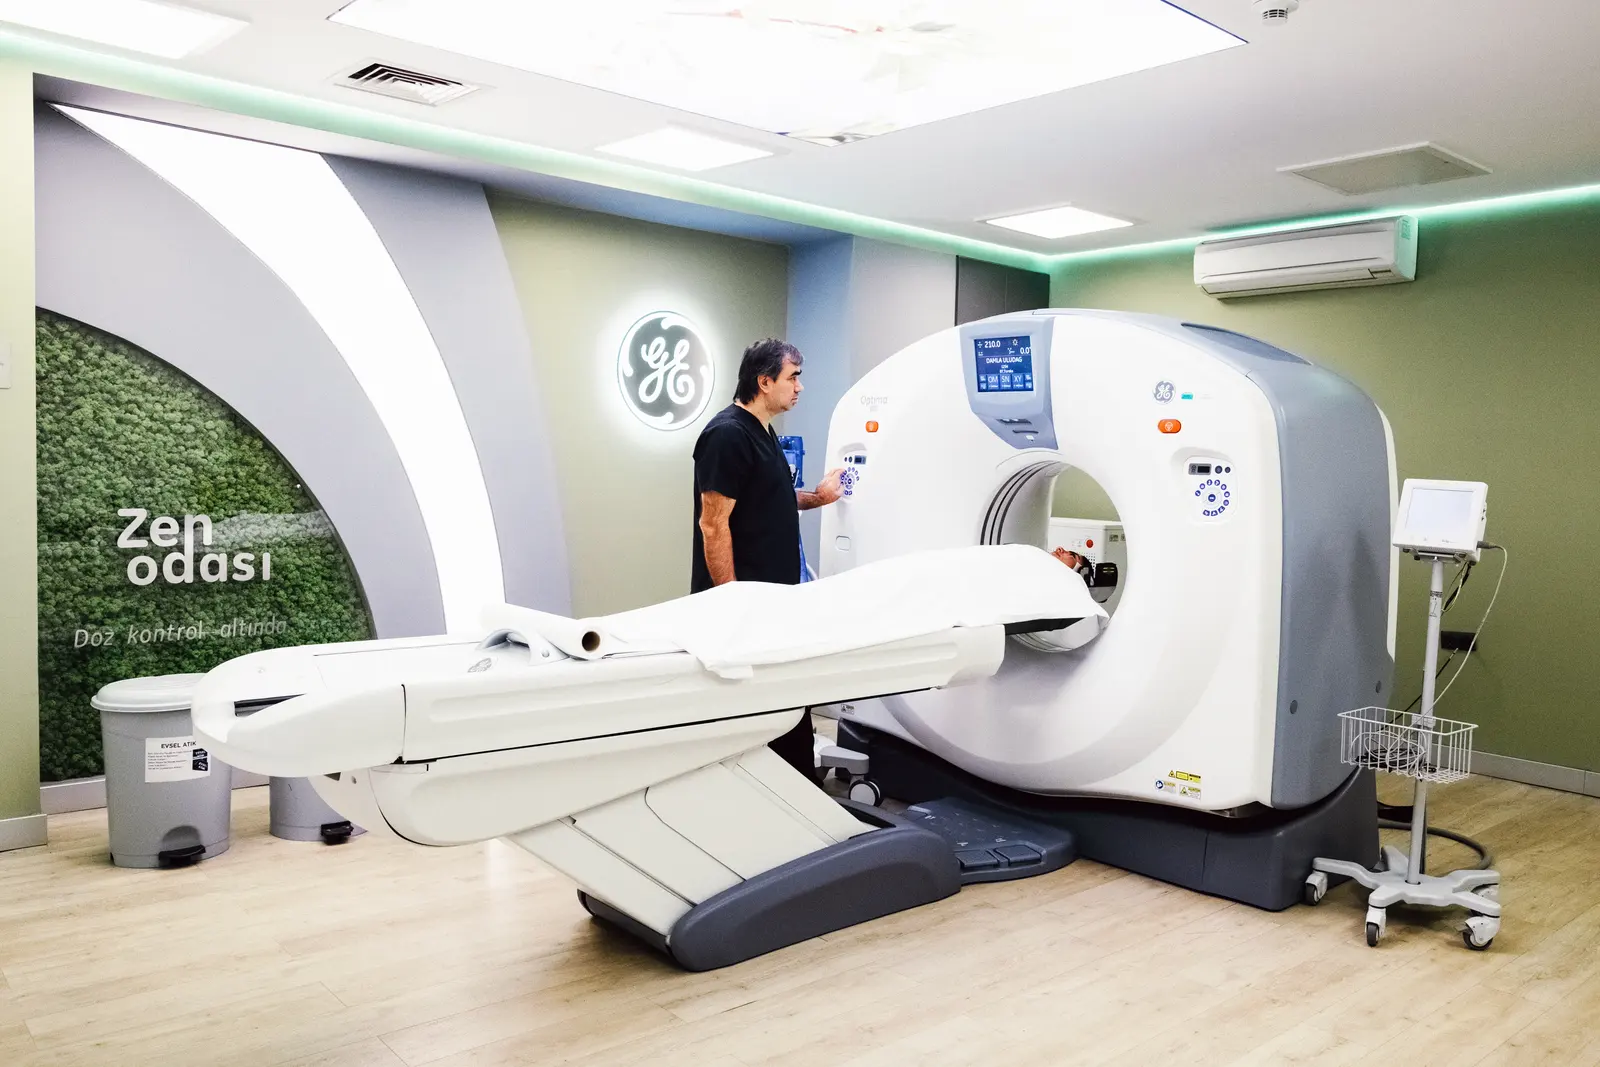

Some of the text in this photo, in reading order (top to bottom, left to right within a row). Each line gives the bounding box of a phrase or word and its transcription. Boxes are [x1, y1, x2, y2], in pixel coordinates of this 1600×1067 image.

[984, 340, 1000, 348] 210.0
[1014, 375, 1022, 383] XY
[860, 395, 888, 407] Optima
[116, 508, 213, 549] Zen
[127, 546, 270, 586] odası
[74, 616, 288, 648] Doz kontrol altında
